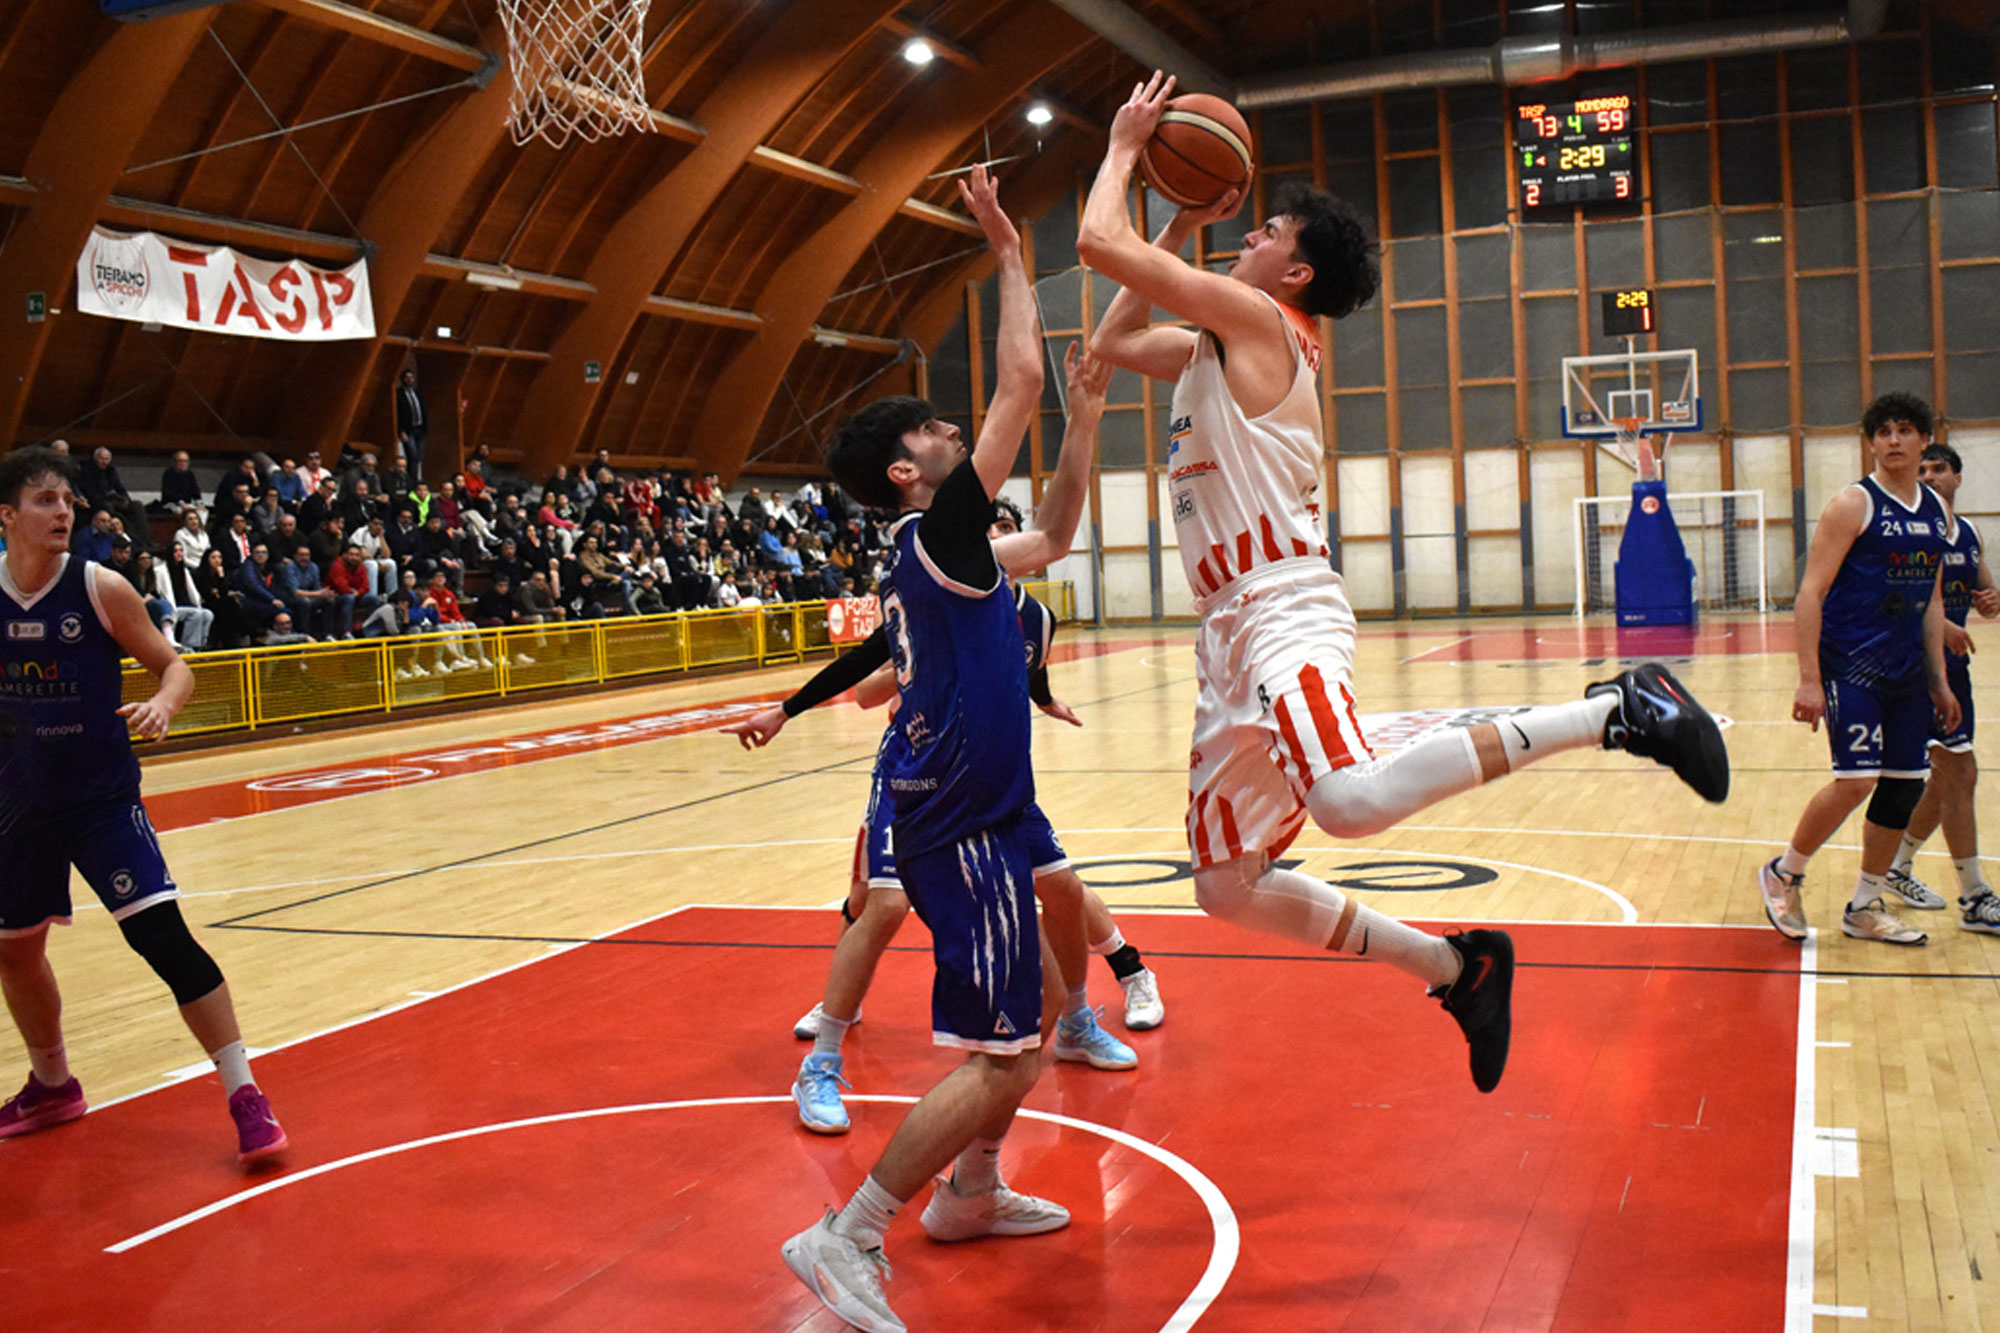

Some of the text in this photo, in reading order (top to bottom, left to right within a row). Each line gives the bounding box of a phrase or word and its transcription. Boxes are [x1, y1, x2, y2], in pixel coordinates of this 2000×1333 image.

[1519, 105, 1546, 118] TASP
[1575, 96, 1629, 113] MONDRAGO
[1532, 116, 1557, 137] 73
[1567, 115, 1582, 133] 4
[1597, 110, 1624, 132] 59
[1560, 145, 1605, 170] 2:29
[1526, 184, 1541, 206] 2
[1615, 176, 1629, 198] 3
[96, 264, 145, 287] TERAMO
[97, 281, 144, 298] A SPICCHI
[168, 245, 355, 334] TASP
[1616, 290, 1648, 309] 2:29
[1642, 306, 1650, 331] 1
[1881, 521, 1902, 536] 24
[1848, 724, 1882, 751] 24
